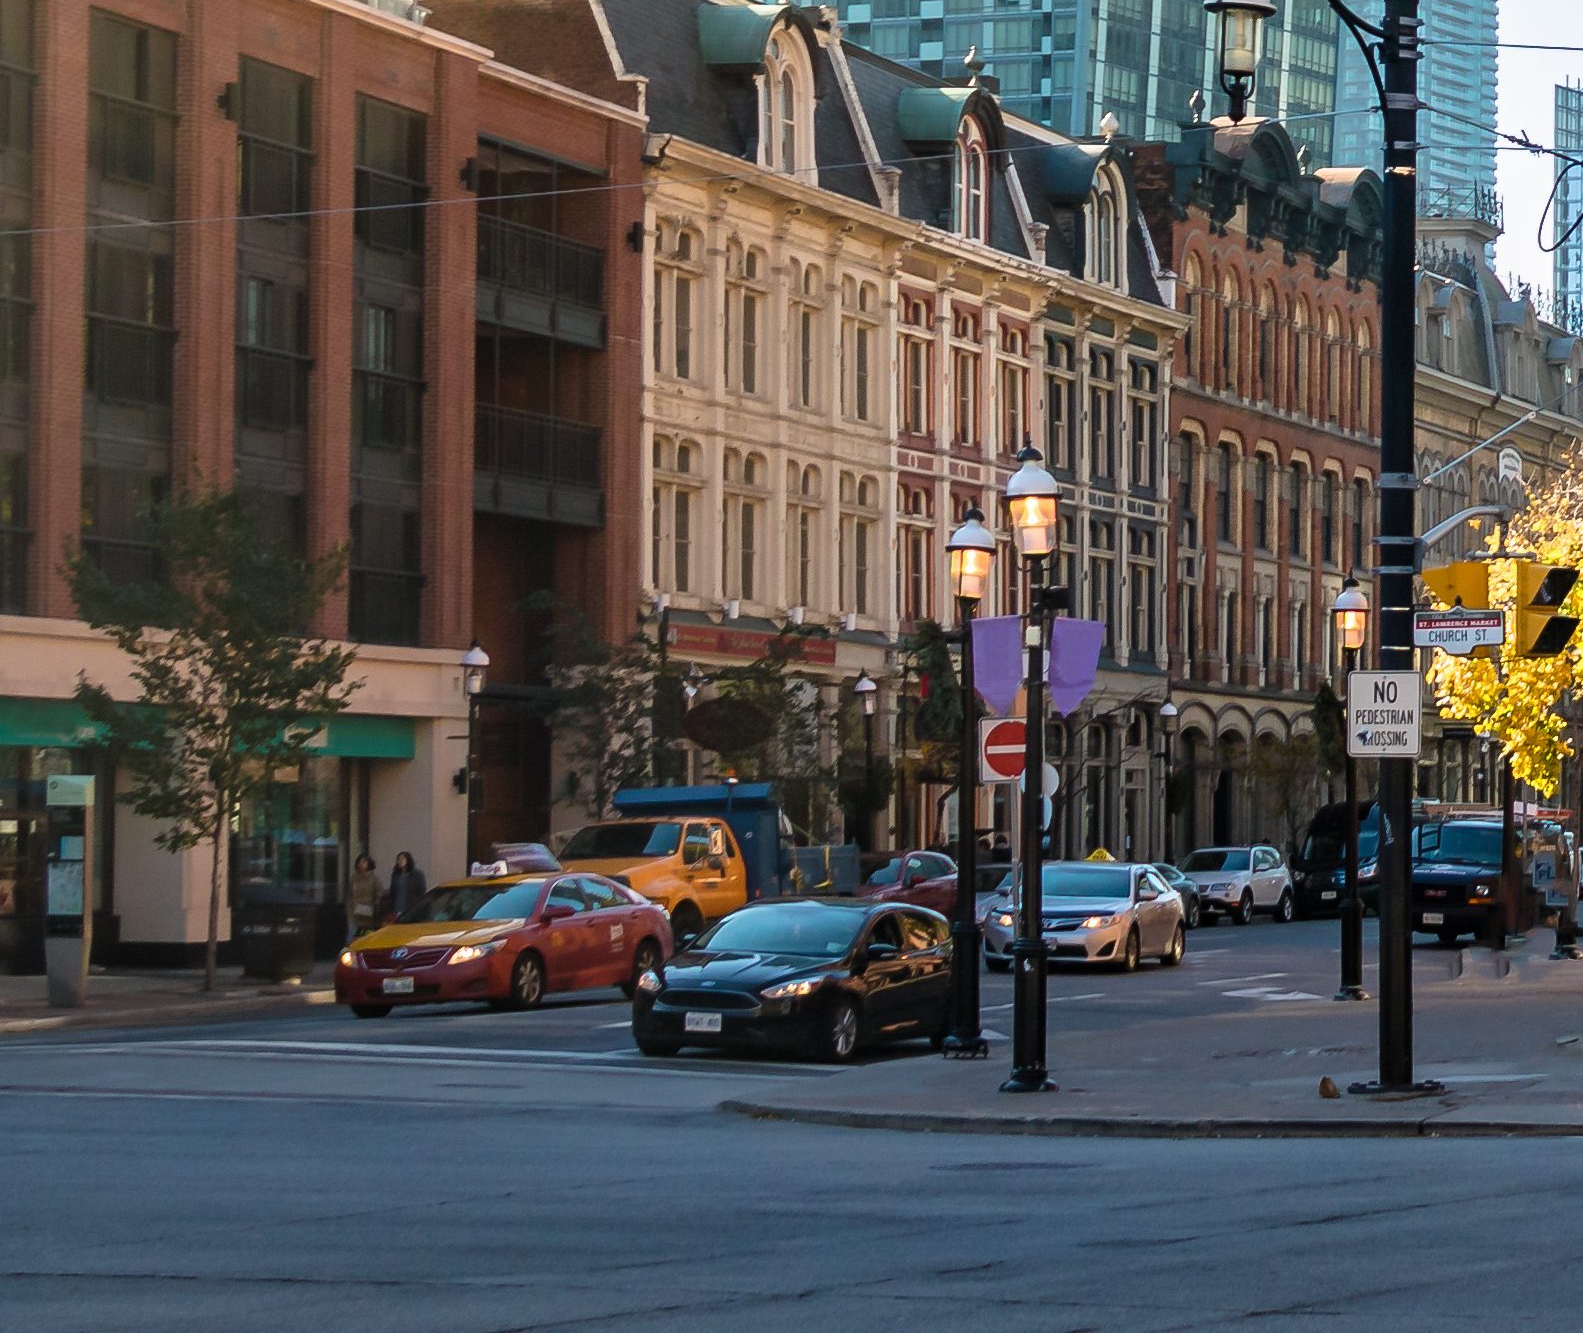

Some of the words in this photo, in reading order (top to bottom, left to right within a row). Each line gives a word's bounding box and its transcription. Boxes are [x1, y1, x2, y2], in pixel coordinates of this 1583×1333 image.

[1431, 620, 1468, 628] LAWRENCE
[1428, 629, 1468, 643] CHURCH
[1373, 680, 1398, 704] NO
[1355, 709, 1414, 725] PEDESTRIAN
[1361, 730, 1408, 747] ROSSING
